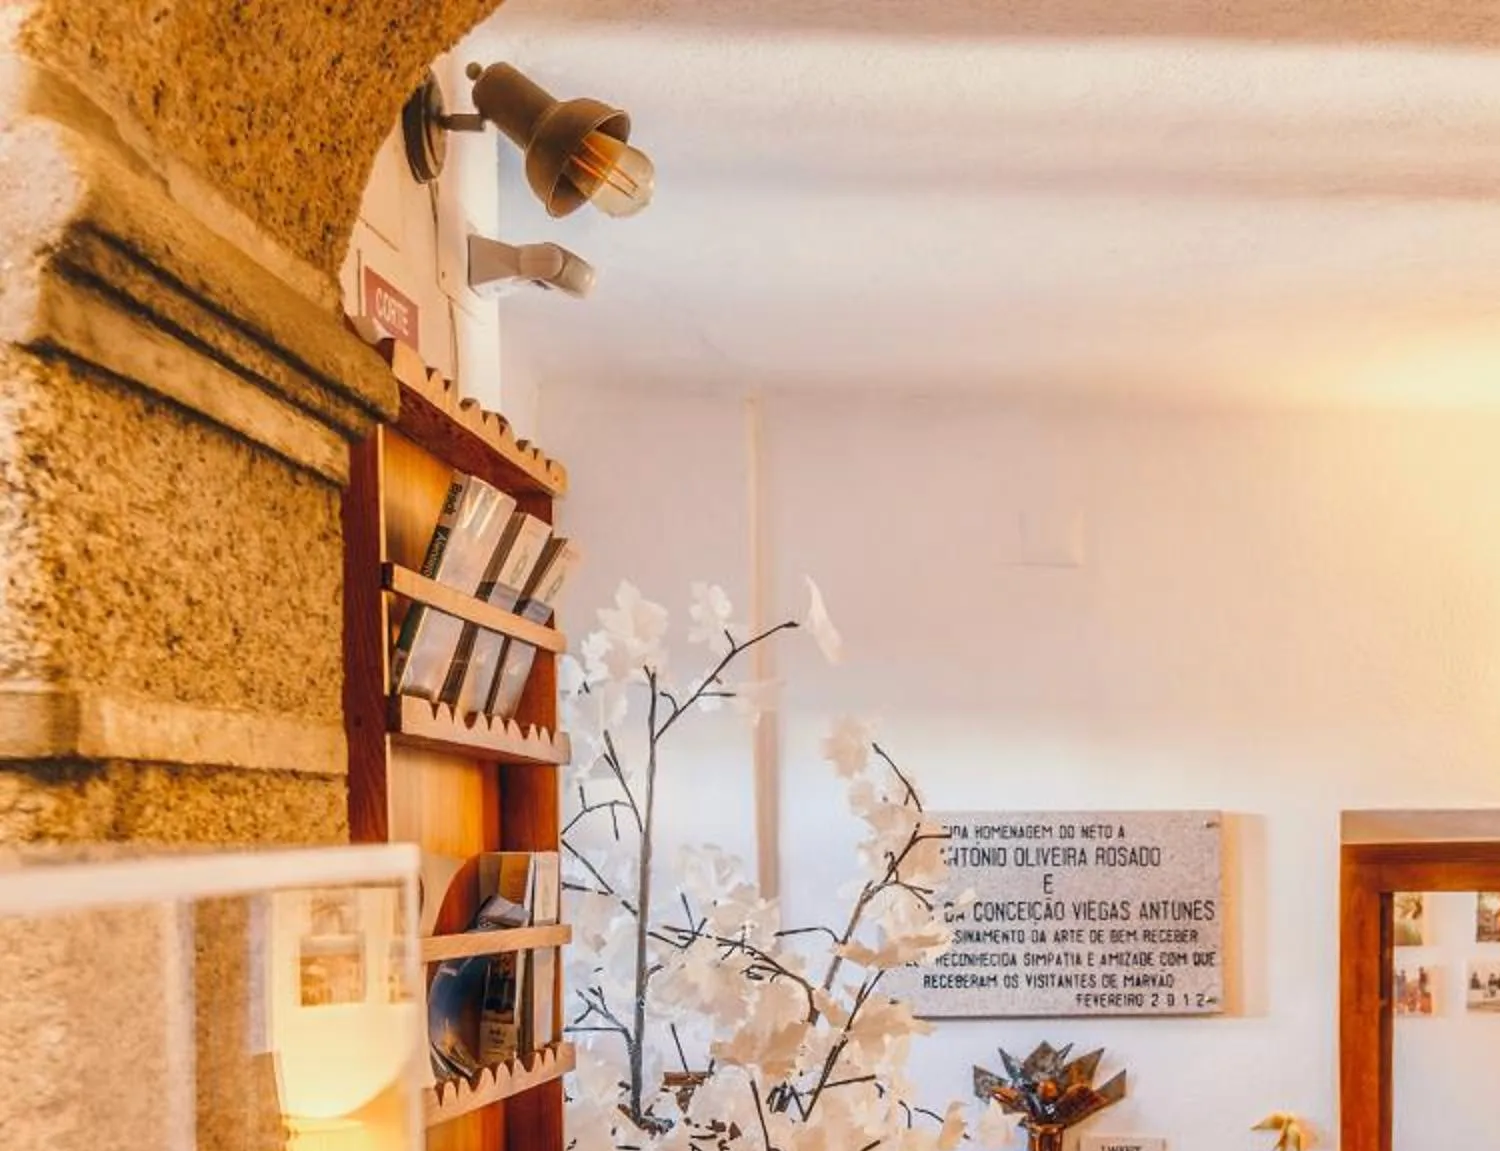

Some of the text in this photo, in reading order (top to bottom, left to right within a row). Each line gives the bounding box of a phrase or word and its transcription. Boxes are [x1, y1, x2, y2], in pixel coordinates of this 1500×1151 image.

[975, 825, 1053, 839] HOMENAGEM
[1059, 825, 1075, 839] DO
[1081, 825, 1113, 839] NETO
[1118, 825, 1125, 839] A
[1014, 847, 1087, 867] OLIVEIRA
[1095, 847, 1161, 867] ROSADO
[1043, 873, 1053, 895] E
[973, 898, 1065, 925] CONCEIÇÃO
[1072, 901, 1131, 921] VIEGAS
[1139, 900, 1215, 921] ANTUNES
[952, 929, 1199, 944] SINAMENTO DA ARTE DE BEM RECEBER
[1023, 952, 1082, 967] SIMPATIA
[1087, 952, 1095, 967] E
[1100, 952, 1155, 967] AMIZADE
[1159, 952, 1189, 967] COM
[1193, 952, 1216, 967] QUE
[923, 974, 999, 989] RECEBERAM
[1003, 974, 1019, 989] OS
[1025, 974, 1097, 989] VISITANTES
[1101, 974, 1117, 989] DE
[1076, 993, 1145, 1007] FEVEREIRO
